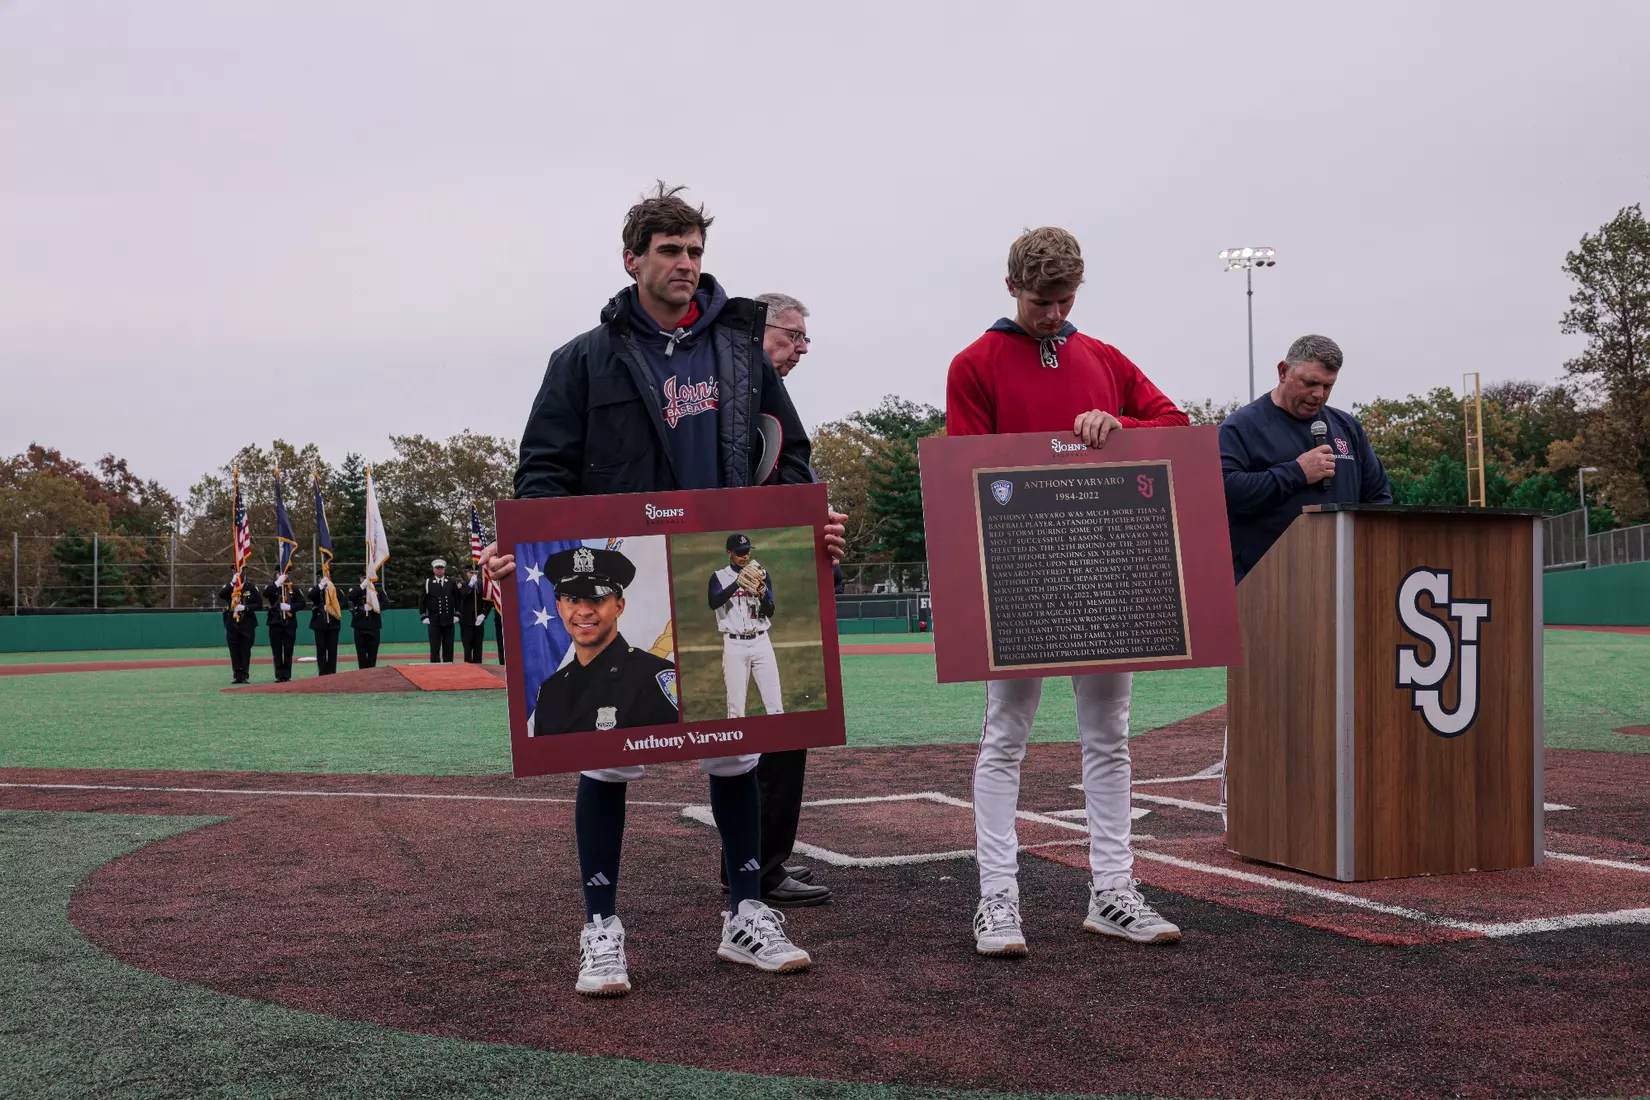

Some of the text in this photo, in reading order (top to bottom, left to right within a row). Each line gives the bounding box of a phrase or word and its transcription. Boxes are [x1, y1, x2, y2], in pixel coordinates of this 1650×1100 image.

[666, 401, 712, 417] BASBALL
[1024, 476, 1125, 488] ANTHONY VARVARO
[1055, 492, 1100, 501] 1984-2022
[623, 730, 744, 751] Anthony Varvaro
